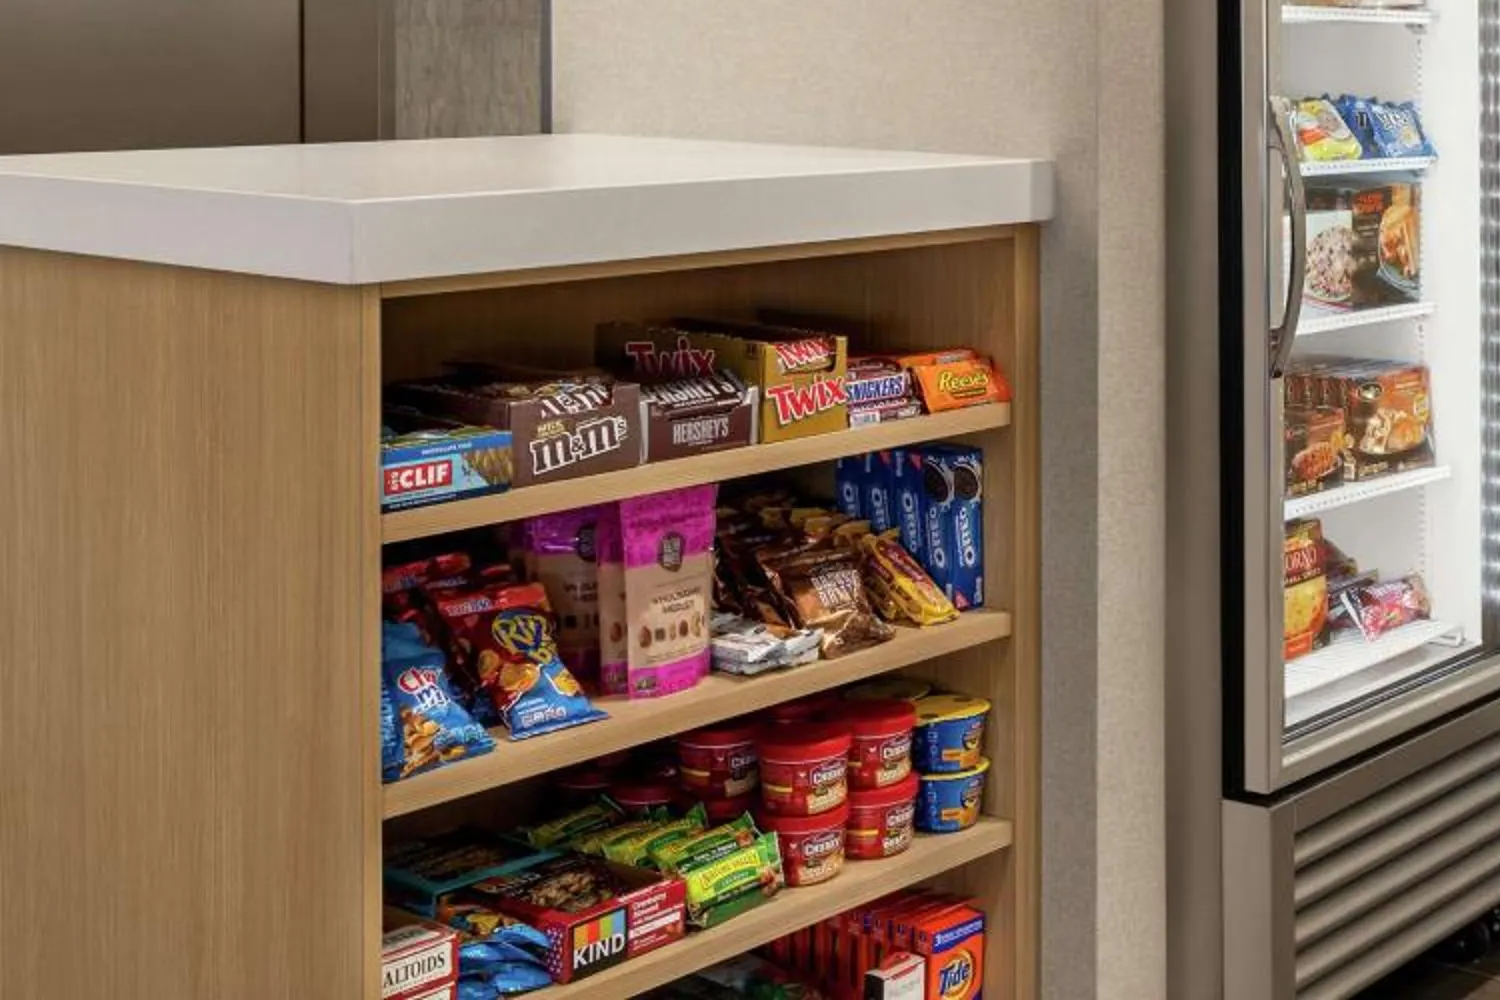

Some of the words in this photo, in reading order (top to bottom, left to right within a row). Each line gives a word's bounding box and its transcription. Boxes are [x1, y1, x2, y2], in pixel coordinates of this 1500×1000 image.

[847, 375, 904, 401] SNICKERS
[672, 417, 730, 445] HERSHEY'S
[400, 463, 450, 489] CLIF
[929, 506, 946, 569] OREO
[959, 506, 976, 567] OREO
[573, 933, 625, 969] KIND
[383, 951, 445, 988] ALTOIDS
[939, 959, 971, 996] Tide
